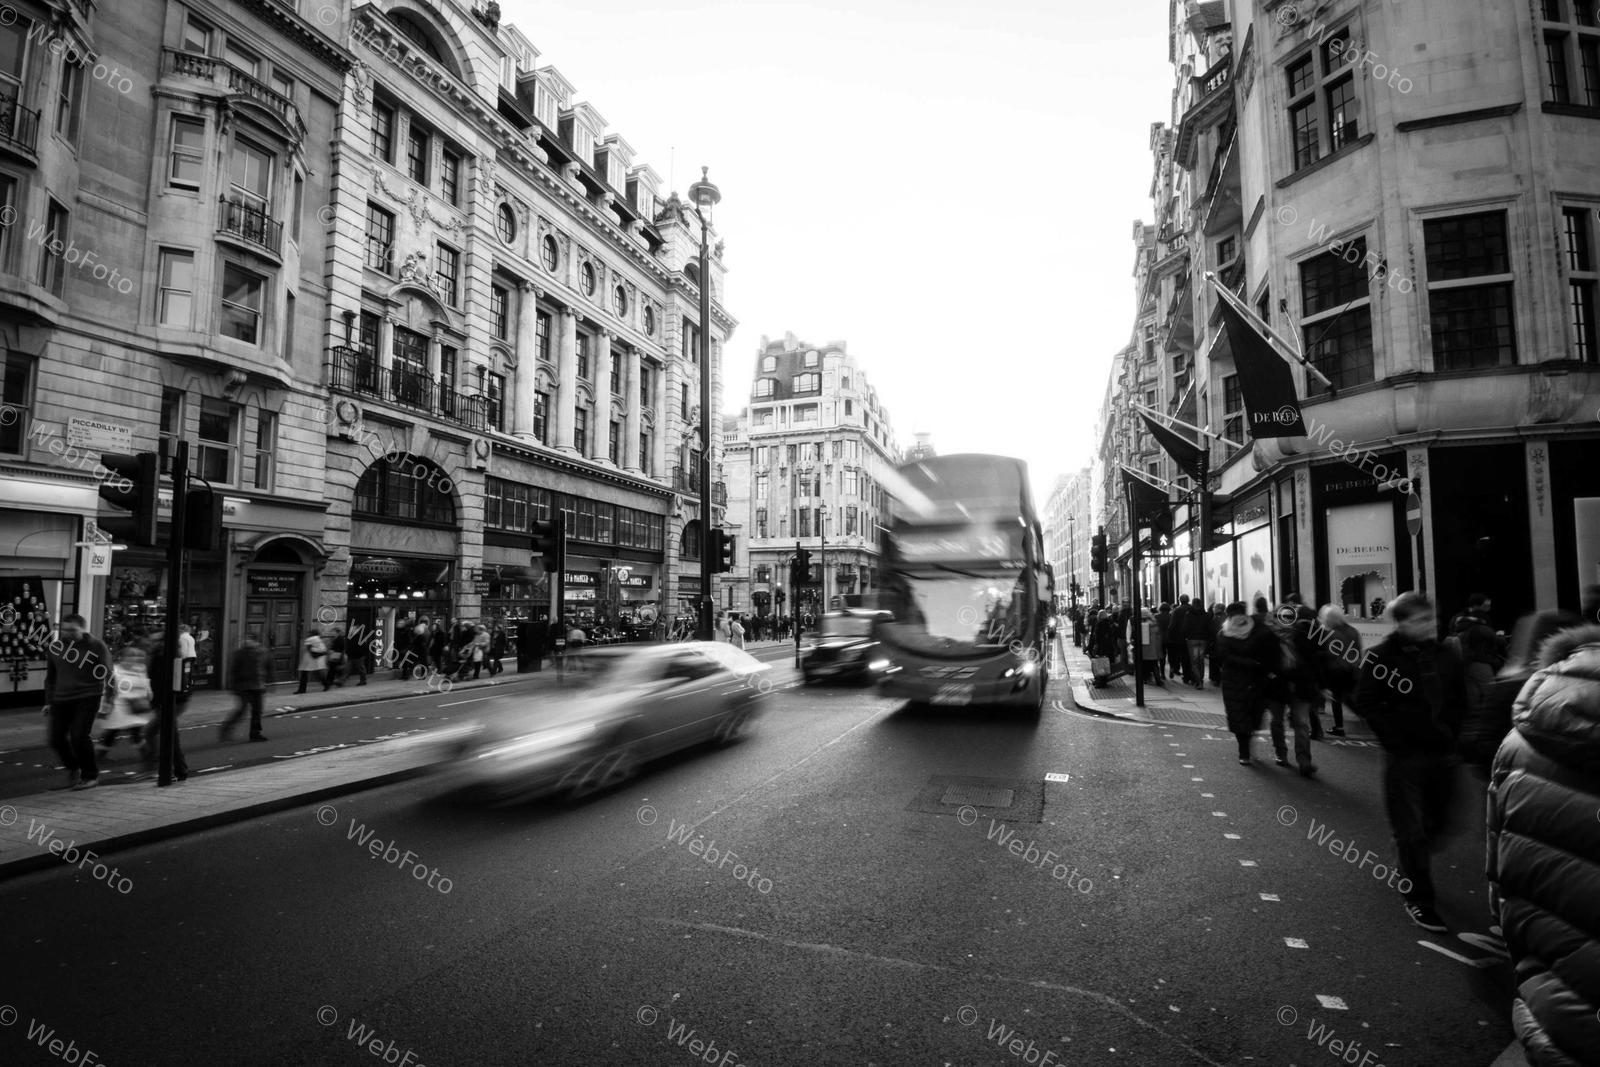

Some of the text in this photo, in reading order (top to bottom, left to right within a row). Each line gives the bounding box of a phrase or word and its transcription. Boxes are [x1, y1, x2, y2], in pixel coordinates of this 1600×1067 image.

[1254, 412, 1270, 423] DE
[72, 418, 117, 432] PICCADILLY
[92, 552, 105, 564] itsu
[376, 619, 384, 666] MONEY
